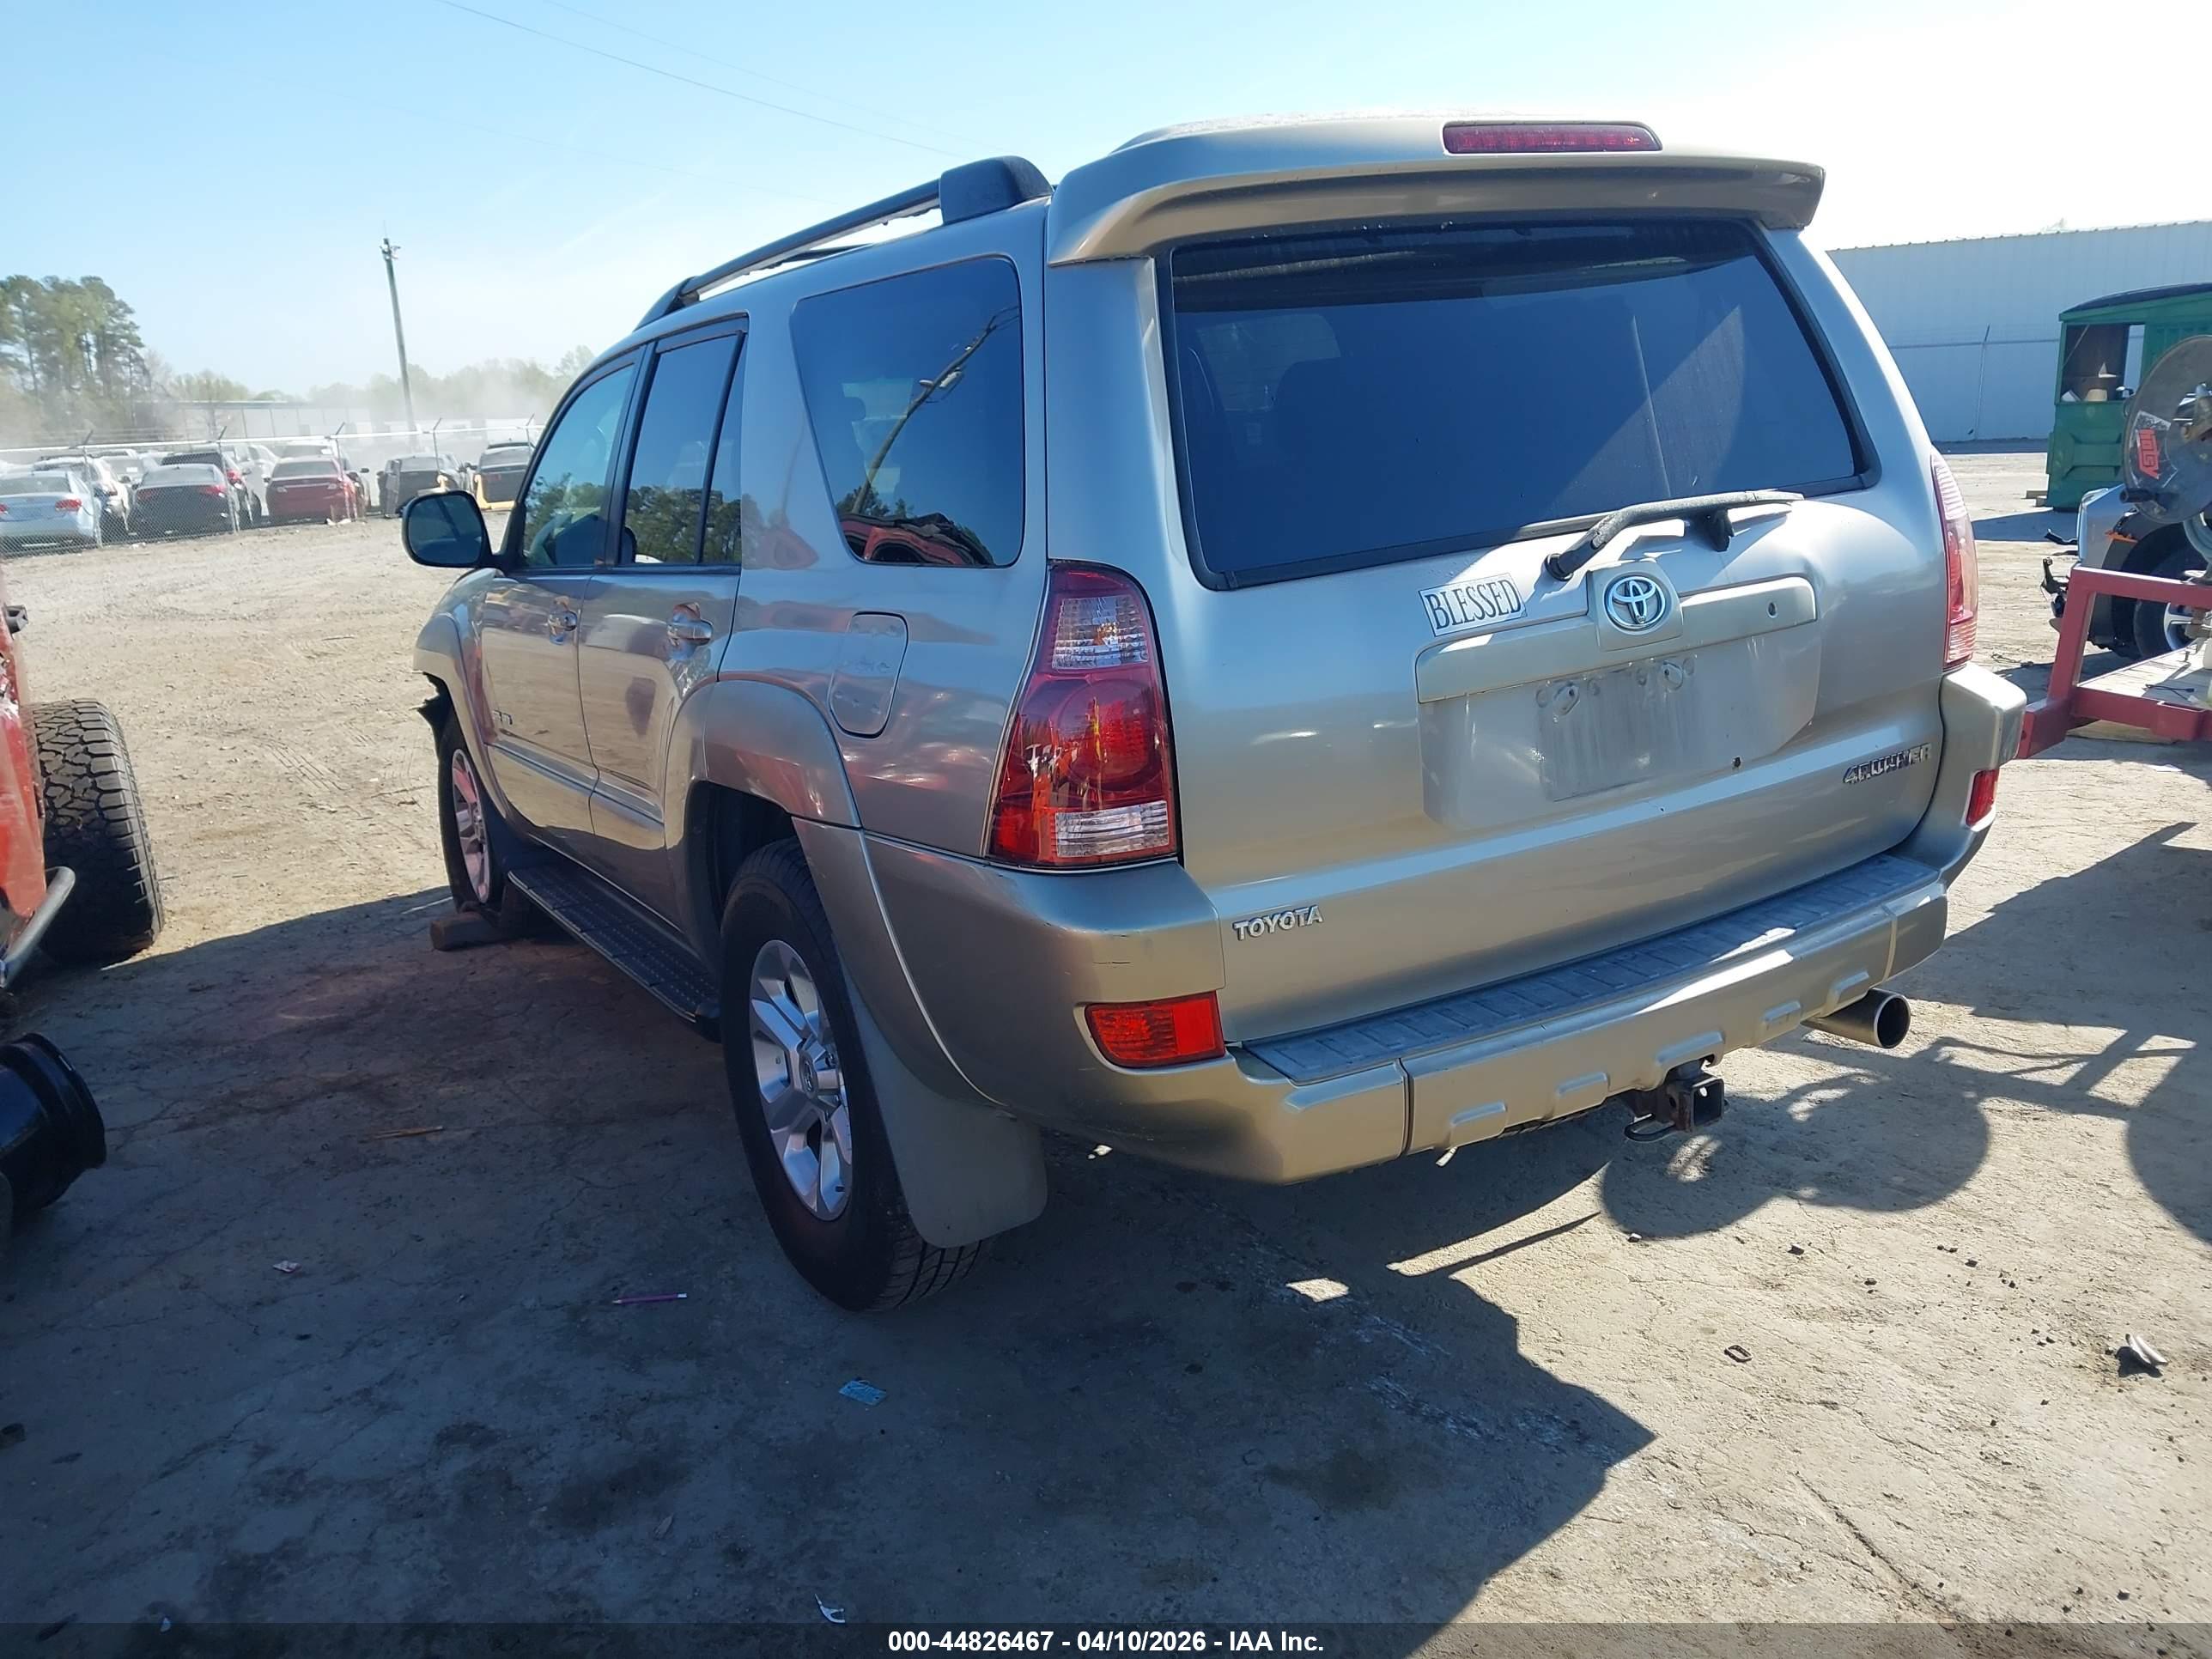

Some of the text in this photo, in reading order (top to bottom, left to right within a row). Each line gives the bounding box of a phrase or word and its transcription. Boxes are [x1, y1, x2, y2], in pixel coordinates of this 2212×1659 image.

[1424, 578, 1522, 630] BLESSED
[1842, 742, 1933, 785] 4RUNNER
[1231, 904, 1324, 941] TOYOTA
